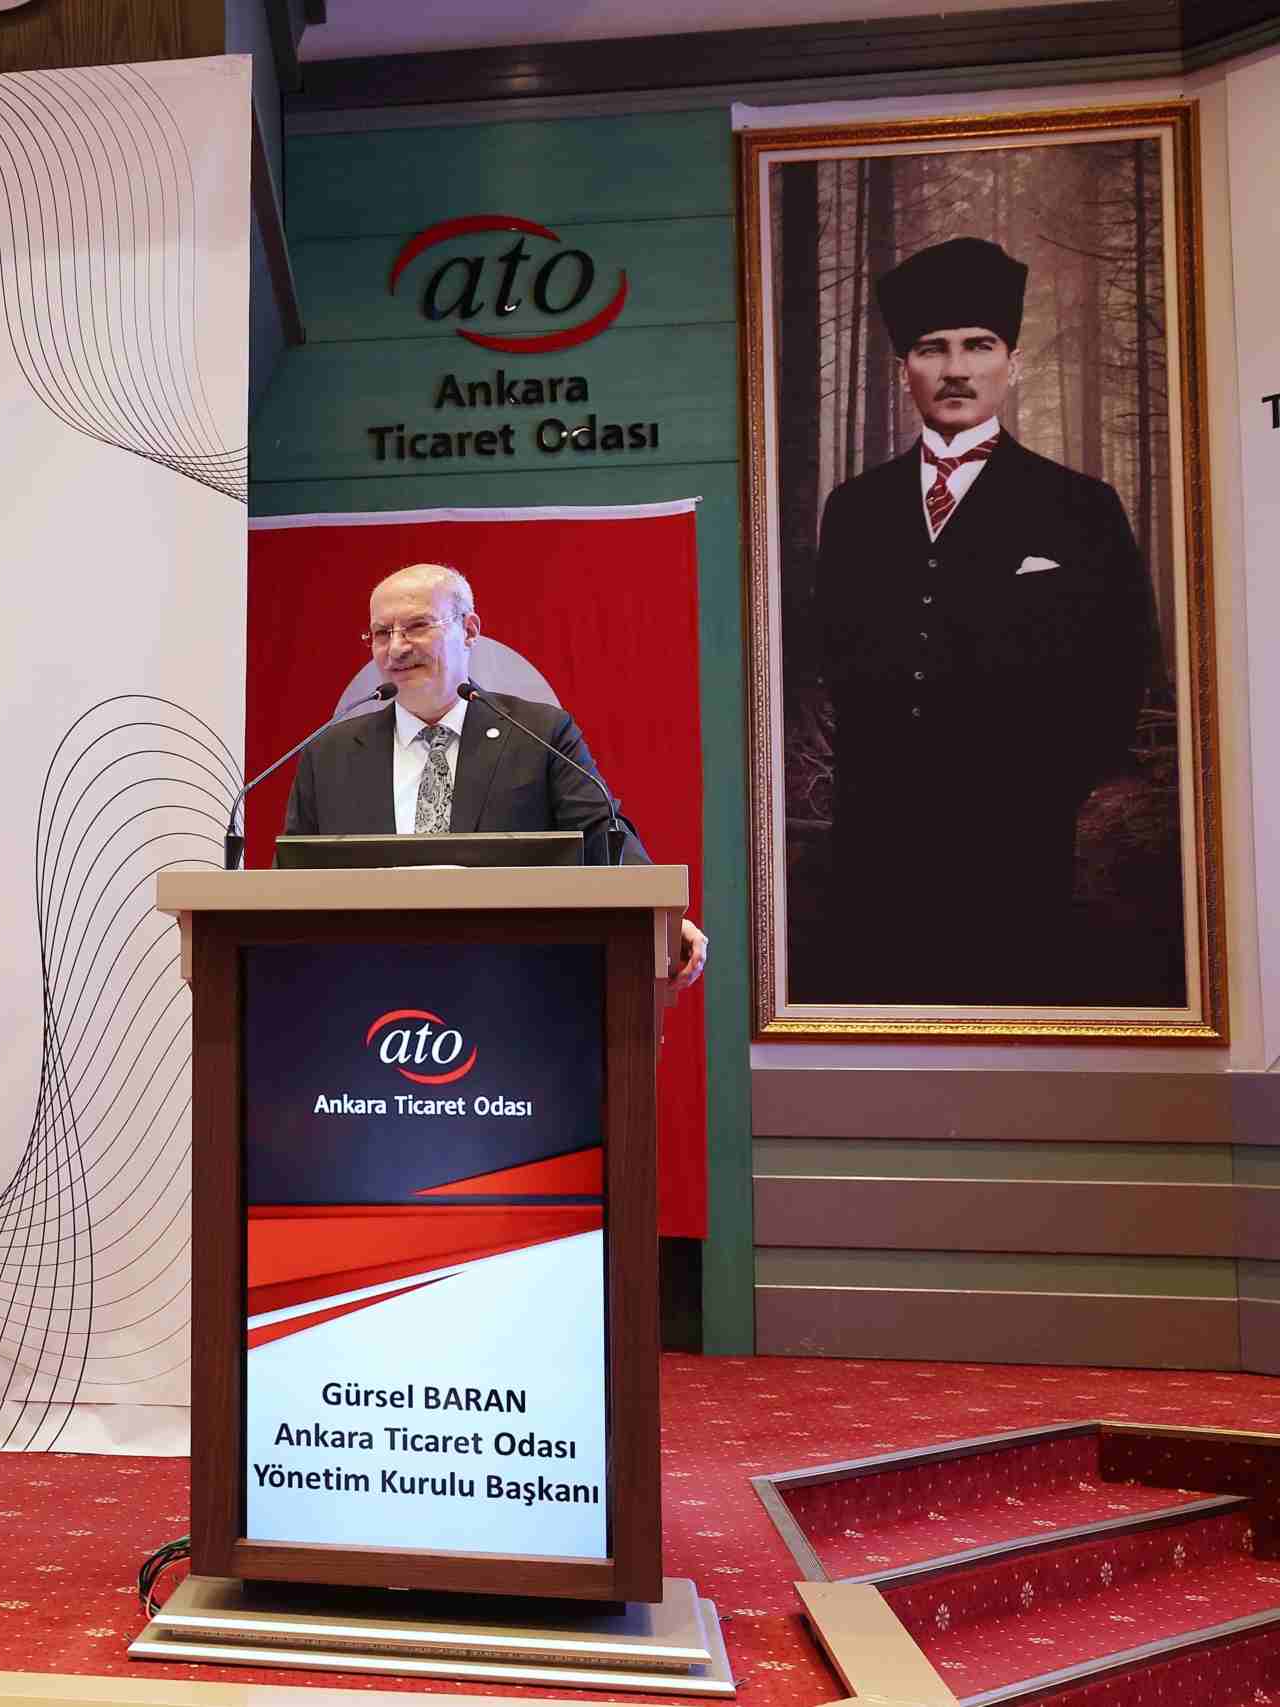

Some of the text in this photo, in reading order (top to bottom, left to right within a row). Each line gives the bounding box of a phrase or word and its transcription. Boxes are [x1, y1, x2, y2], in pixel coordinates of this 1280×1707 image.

[421, 236, 595, 321] ato
[434, 369, 589, 410] Ankara
[368, 414, 660, 462] Ticaret Odası
[379, 1022, 463, 1065] ato
[313, 1093, 532, 1117] Ankara Ticaret Odası
[322, 1382, 526, 1413] Gürsel BARAN
[274, 1422, 576, 1460] Ankara Ticaret Odası
[253, 1463, 599, 1507] Yönetim Kurulu Başkanı
